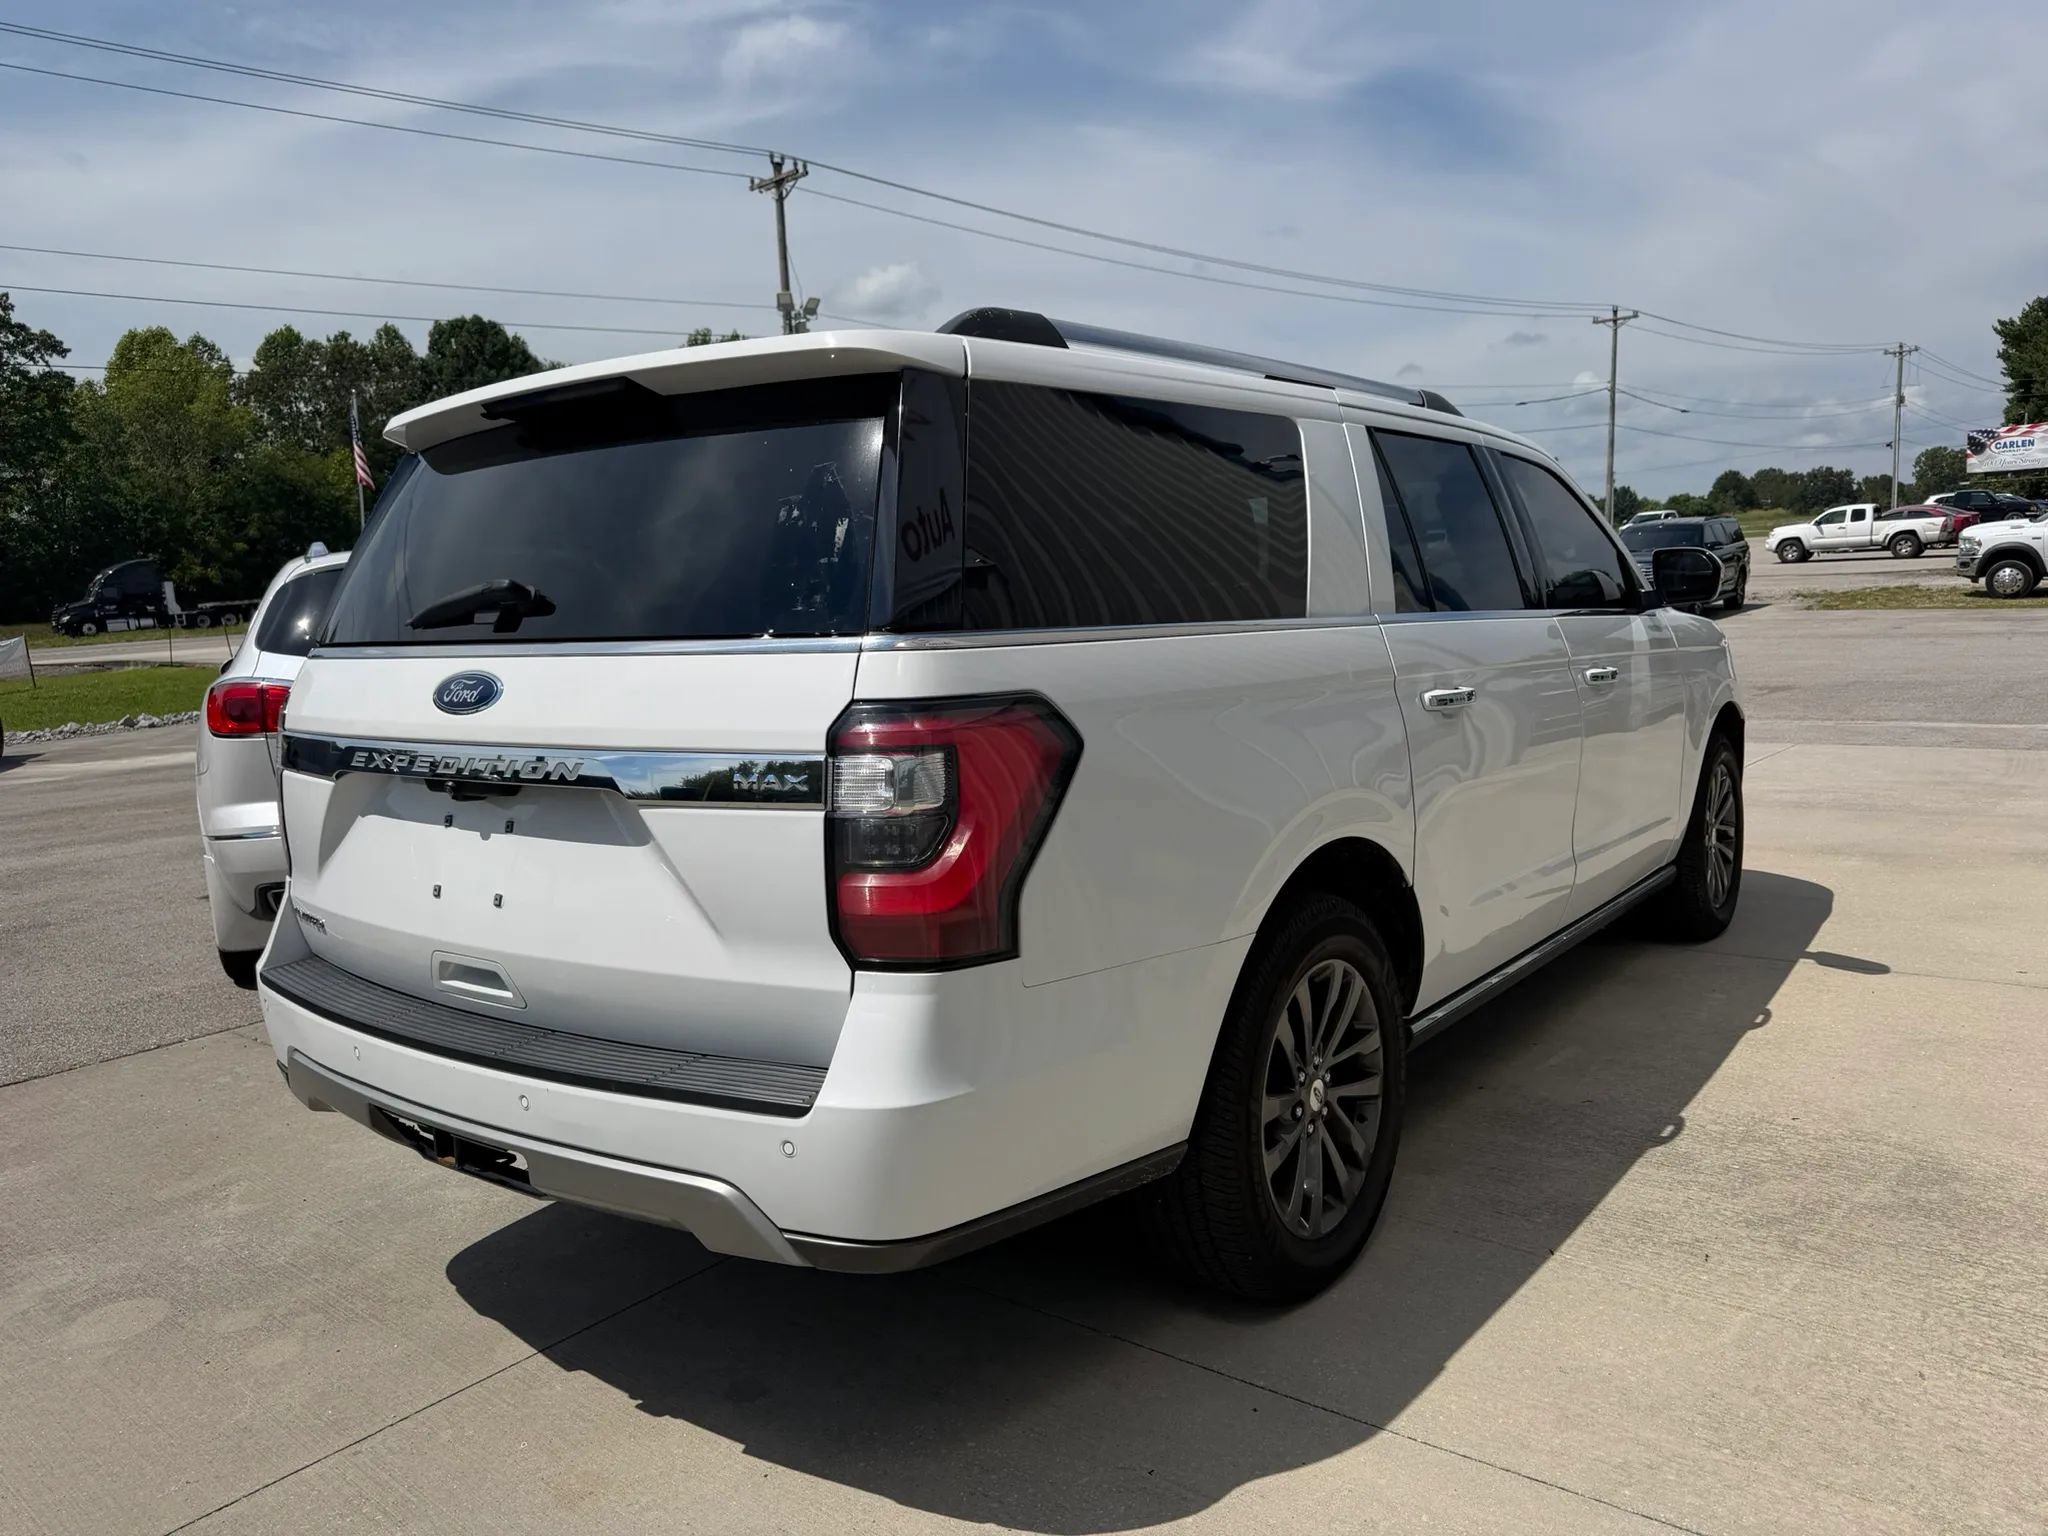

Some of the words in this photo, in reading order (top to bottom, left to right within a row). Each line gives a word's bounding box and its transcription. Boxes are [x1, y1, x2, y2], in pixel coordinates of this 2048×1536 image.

[1994, 439, 2035, 450] CARLEN
[443, 679, 484, 703] Ford
[350, 750, 585, 782] EXPEDITION
[732, 772, 809, 793] MAX
